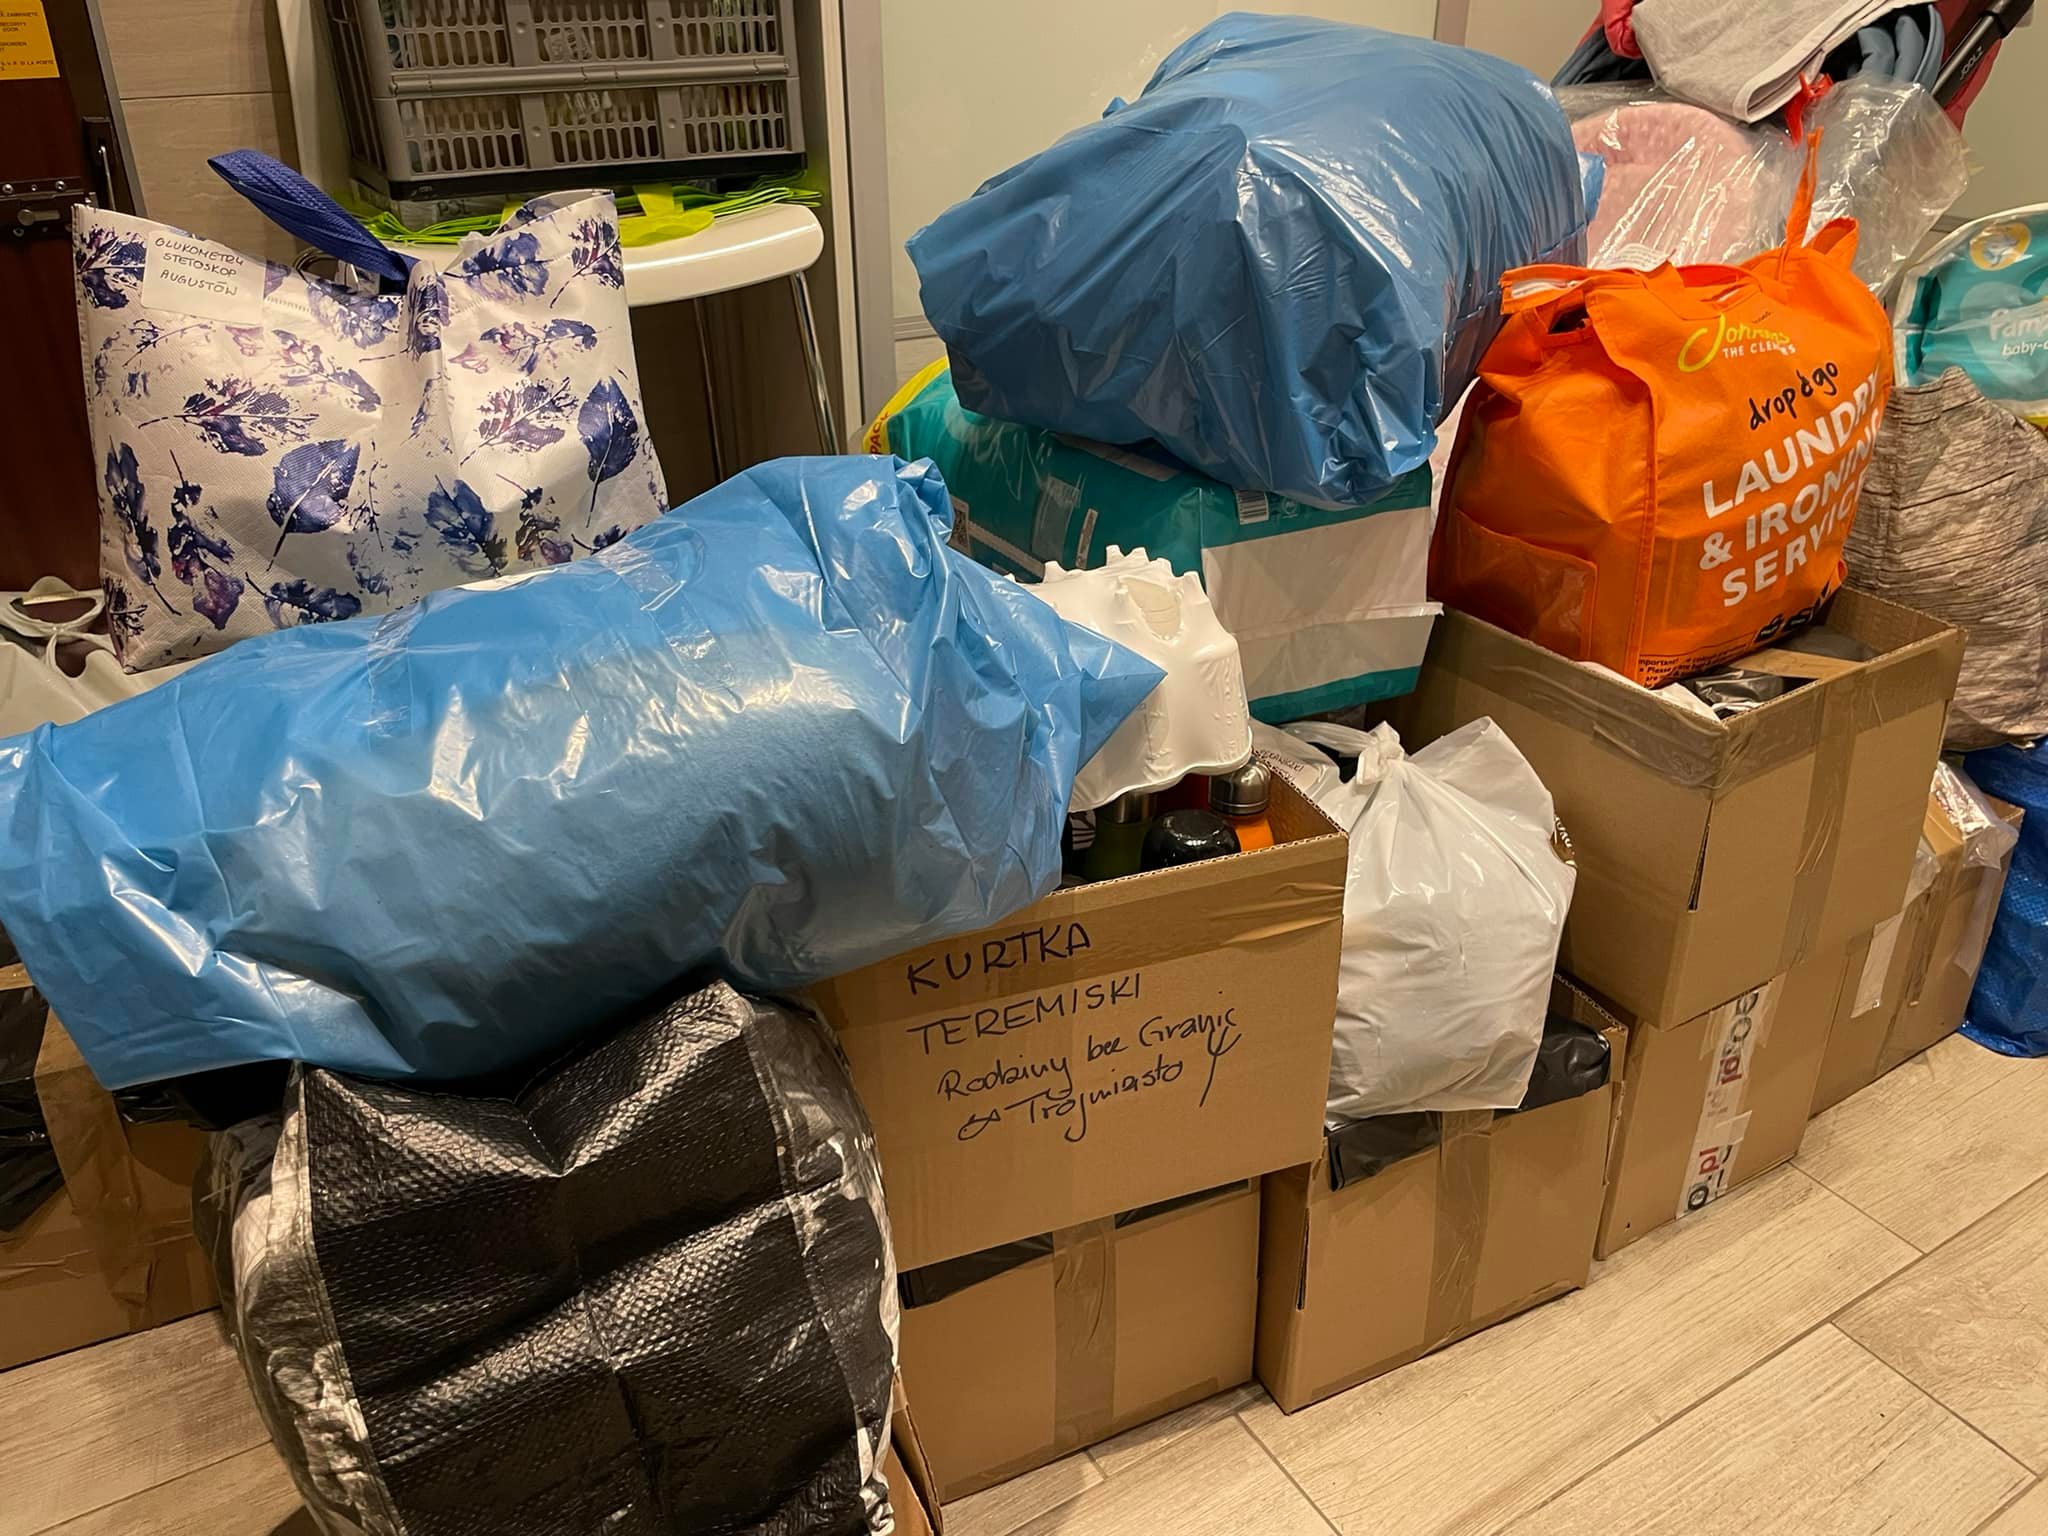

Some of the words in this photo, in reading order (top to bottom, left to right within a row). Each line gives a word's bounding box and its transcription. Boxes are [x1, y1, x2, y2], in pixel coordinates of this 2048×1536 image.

[163, 252, 237, 277] STETOSKOP
[1722, 346, 1744, 359] THE
[1749, 388, 1797, 431] drop
[1812, 362, 1839, 396] go
[1703, 363, 1879, 519] LAUNDRY
[1699, 532, 1733, 570] &
[907, 922, 1091, 996] KURTKA
[907, 973, 1141, 1056] TEREMISKI
